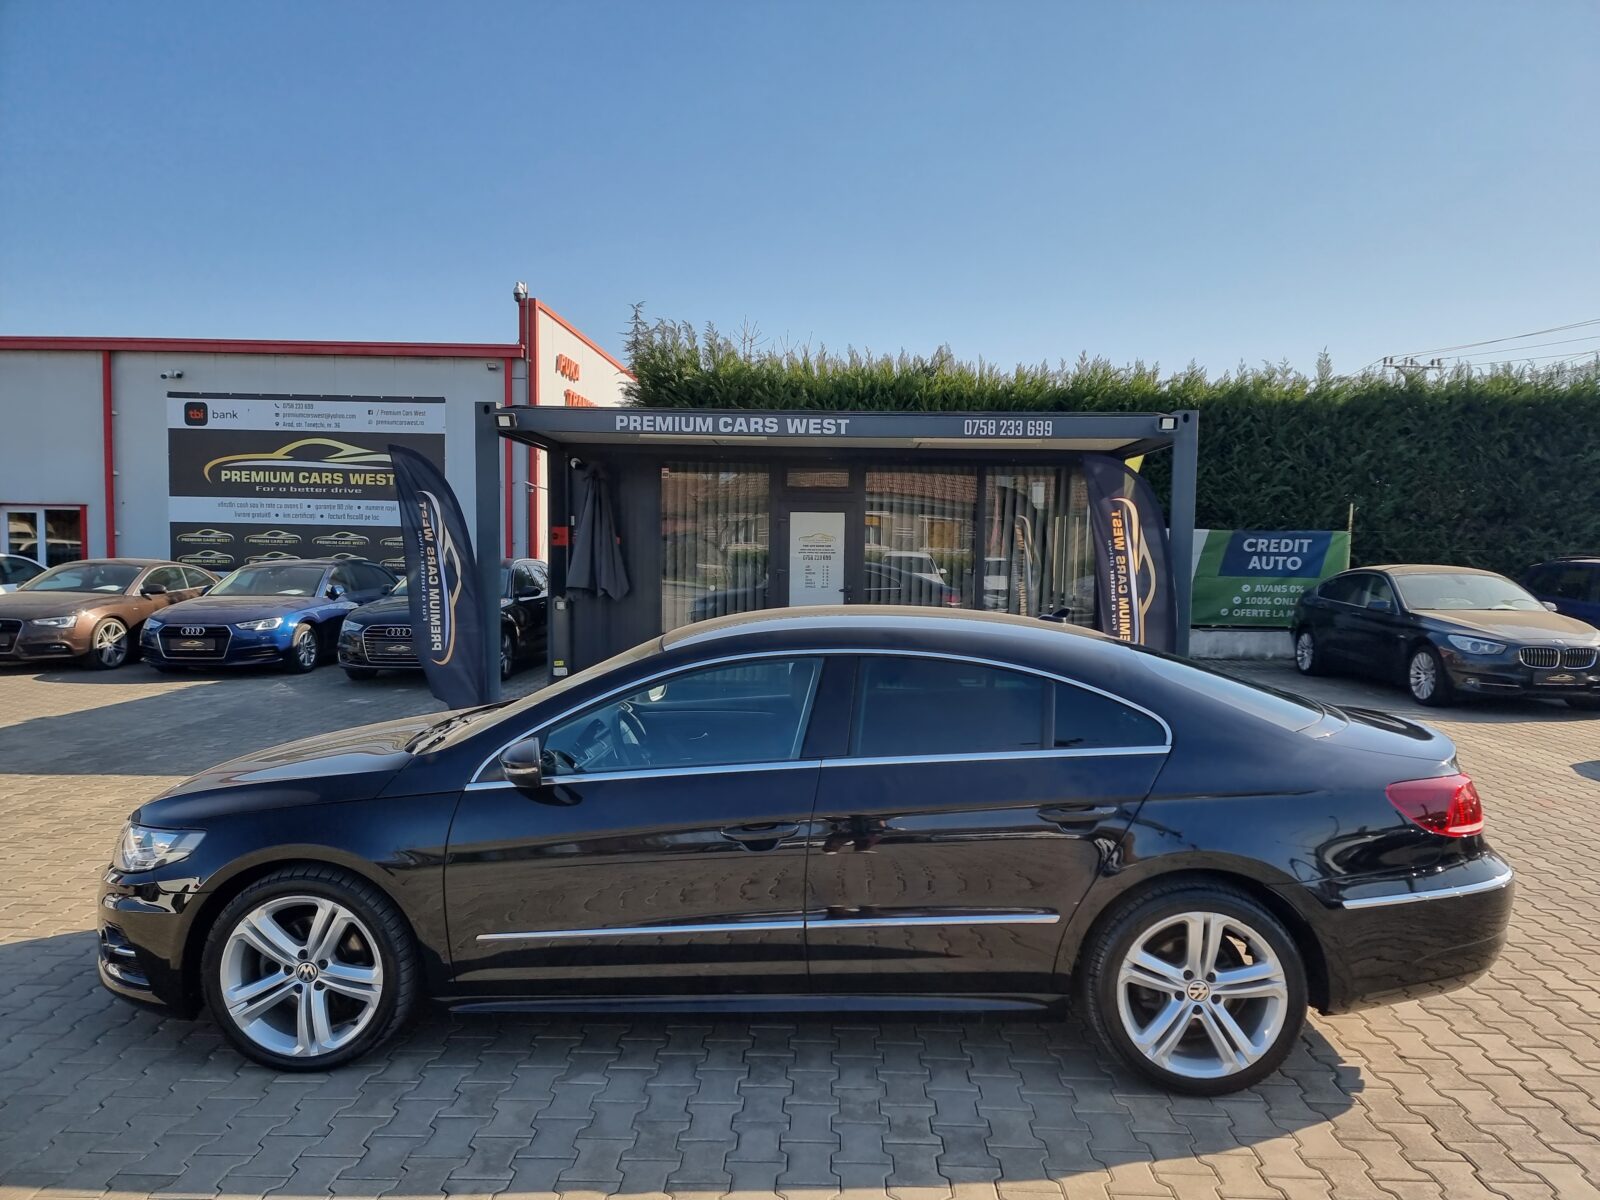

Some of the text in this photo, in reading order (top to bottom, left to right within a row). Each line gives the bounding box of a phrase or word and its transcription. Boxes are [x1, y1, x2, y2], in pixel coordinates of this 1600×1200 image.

[189, 409, 238, 419] tbi bank
[615, 415, 850, 435] PREMIUM CARS WEST
[964, 419, 1053, 437] 0758 233 699
[221, 470, 395, 486] PREMIUM CARS WEST
[290, 486, 328, 494] better
[1242, 538, 1313, 553] CREDIT
[1247, 555, 1303, 571] AUTO
[1254, 584, 1305, 594] AVANS 0%
[1245, 596, 1272, 605] 100%
[1232, 608, 1271, 617] OFERTE
[1272, 609, 1285, 618] LA
